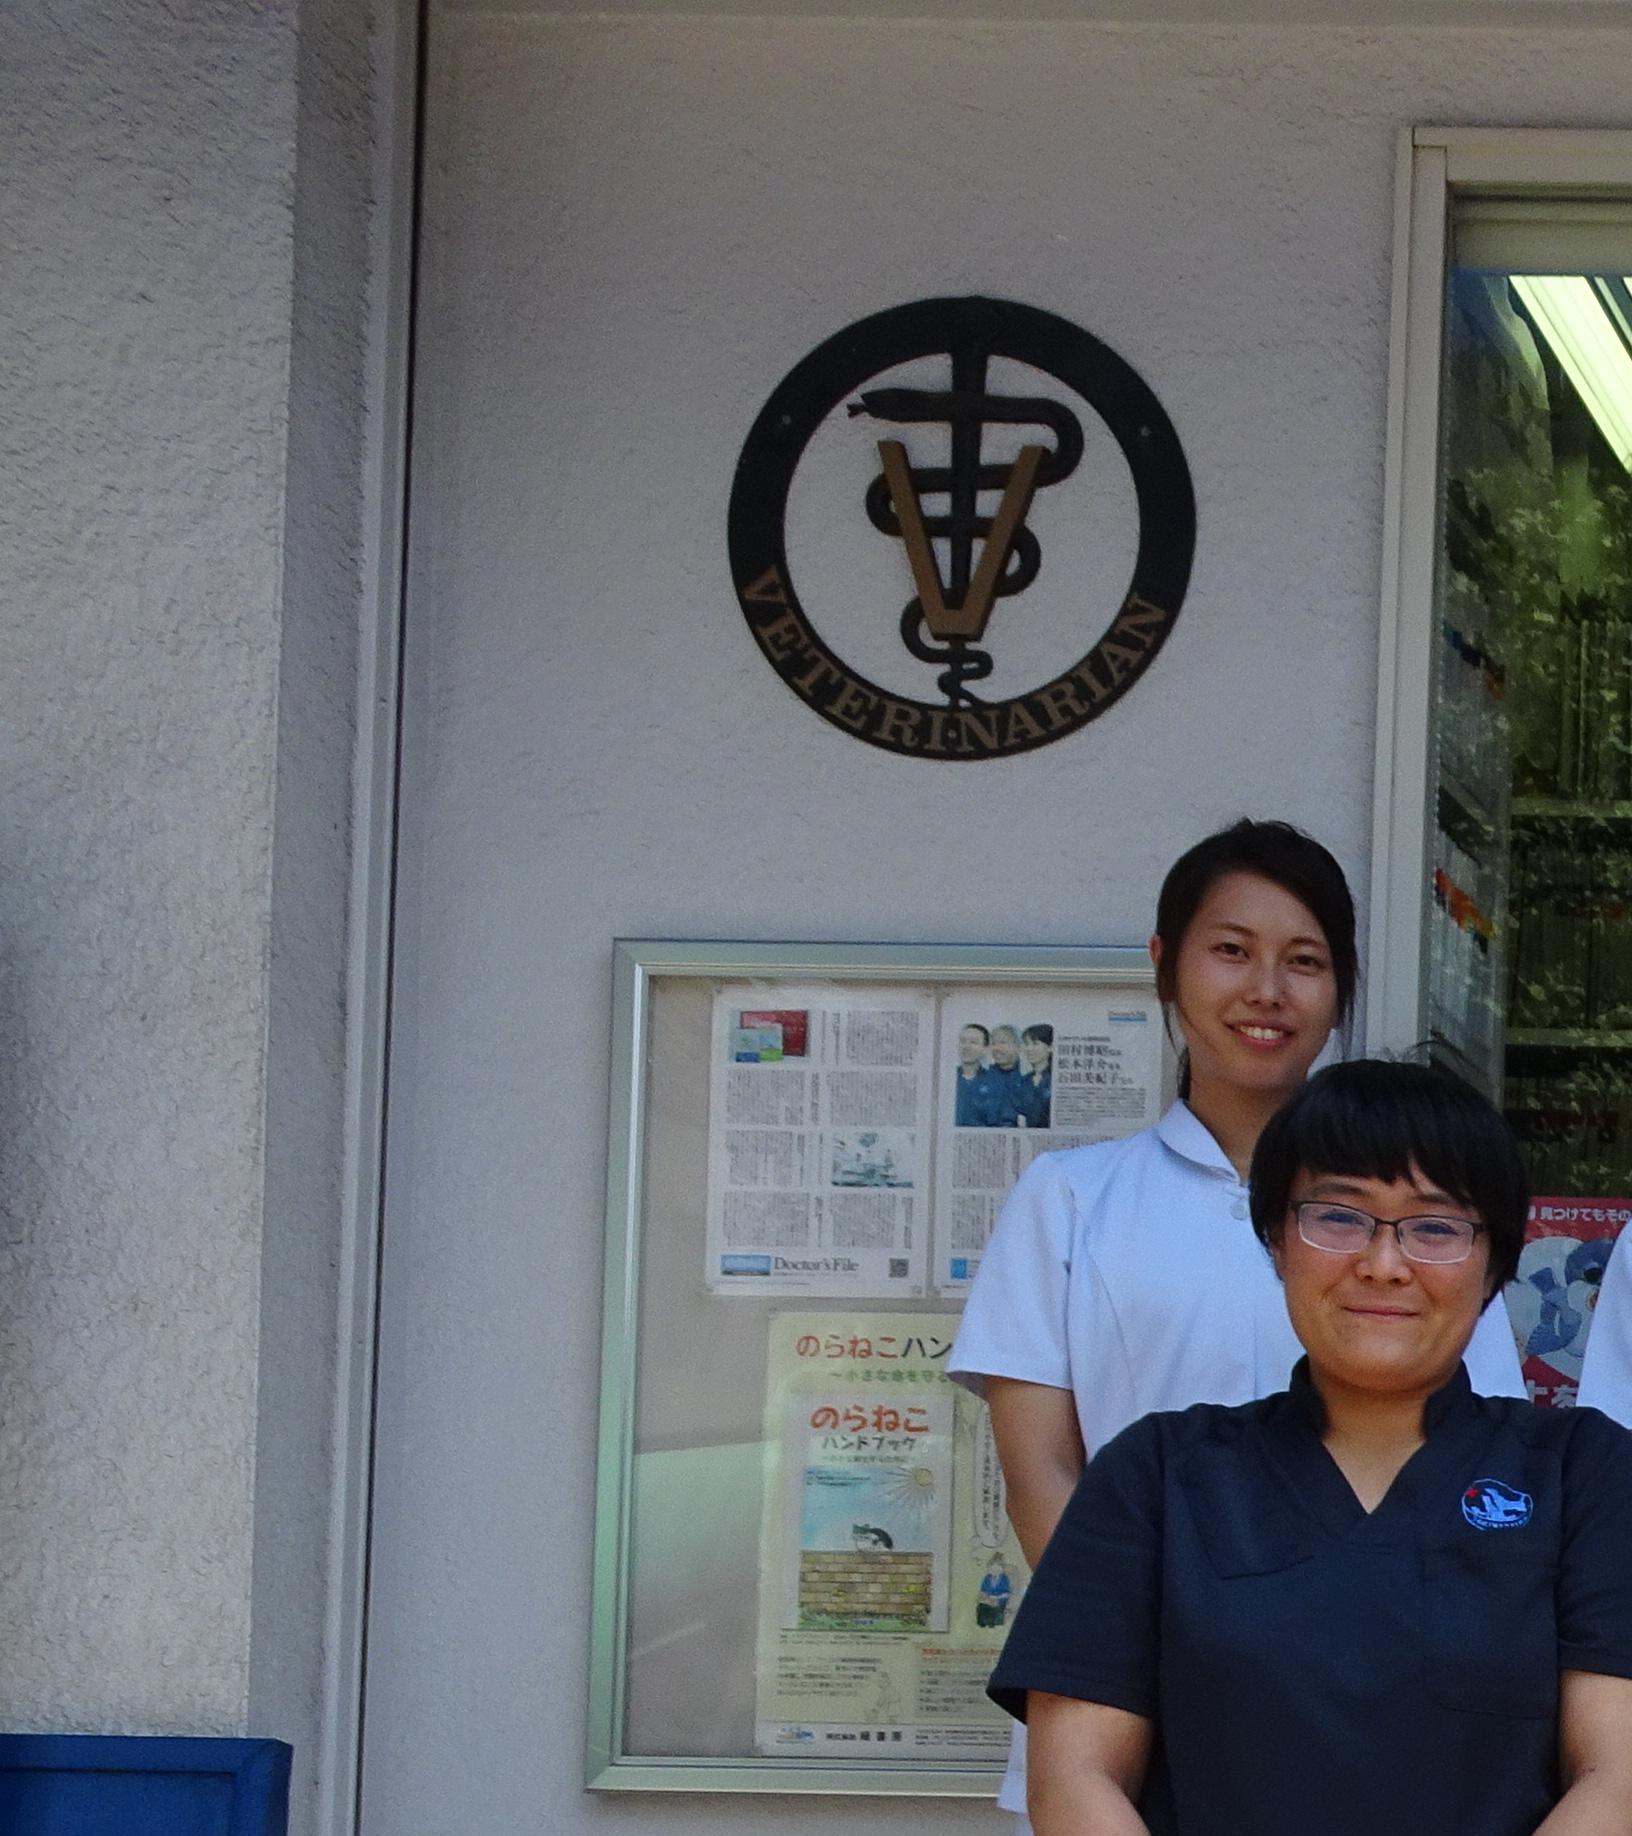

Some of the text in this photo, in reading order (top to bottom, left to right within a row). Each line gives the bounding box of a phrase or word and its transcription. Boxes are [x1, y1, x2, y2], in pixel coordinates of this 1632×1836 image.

[741, 564, 1166, 754] VETERINARIAN
[774, 1257, 860, 1272] Doctor's File
[796, 1334, 952, 1359] のらねこハン
[810, 1404, 929, 1433] のらねこ
[822, 1436, 917, 1451] ハンドブック
